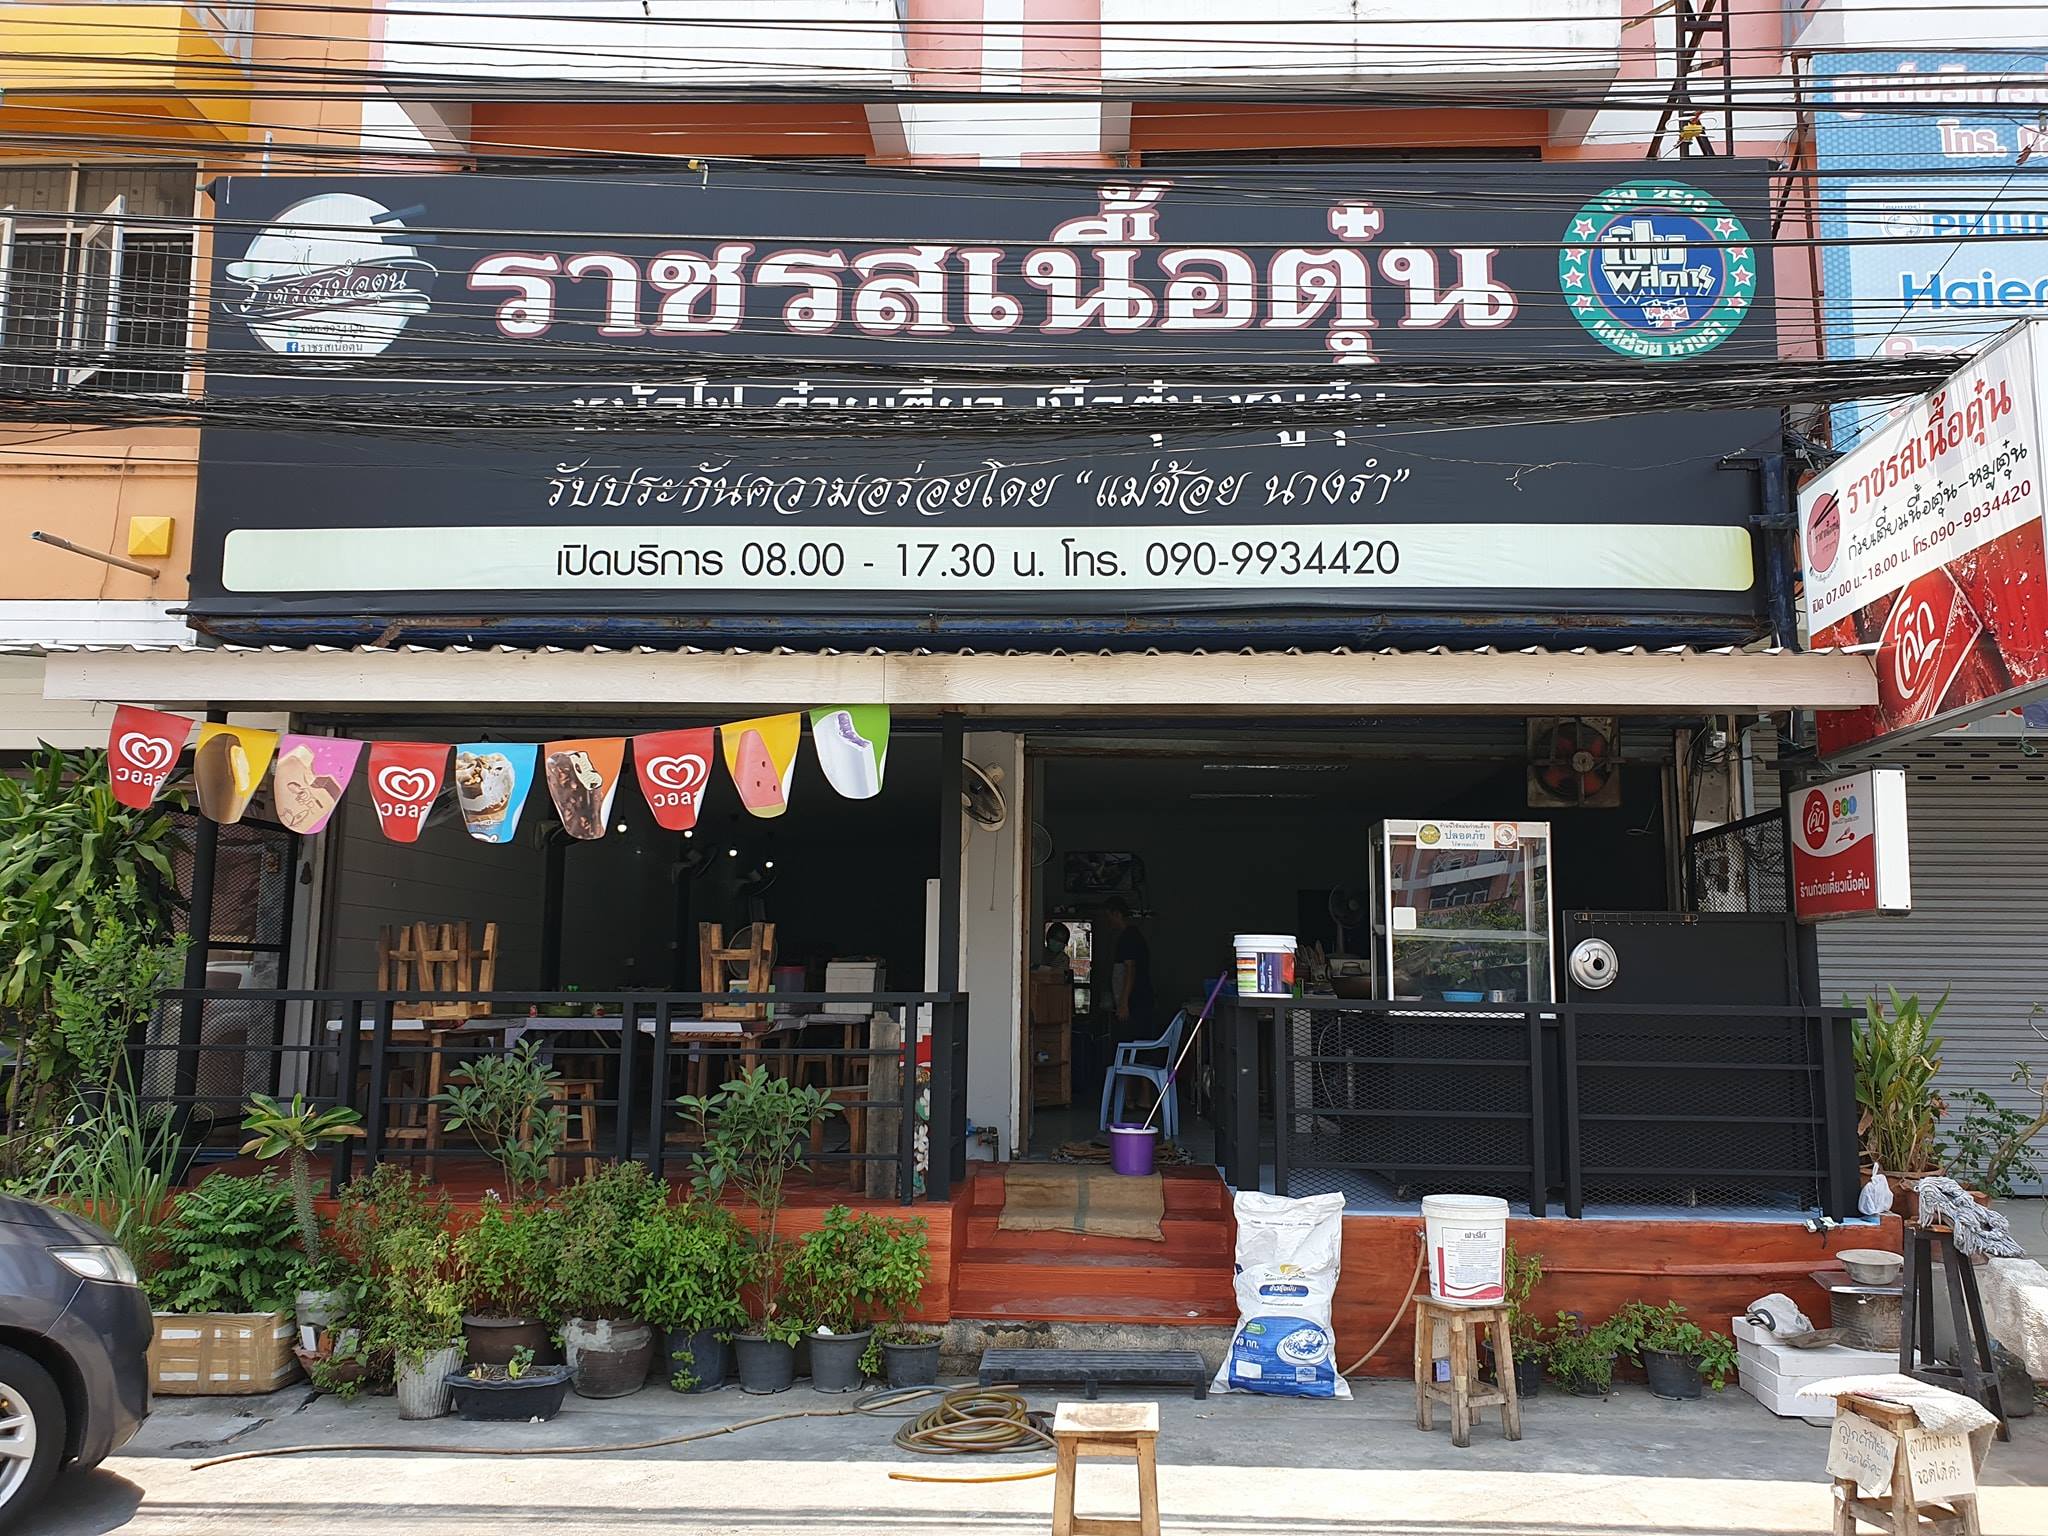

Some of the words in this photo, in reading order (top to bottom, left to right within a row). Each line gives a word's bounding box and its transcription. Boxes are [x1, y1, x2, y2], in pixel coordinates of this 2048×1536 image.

[467, 180, 1518, 364] ราชรสเนื้อตุ๋น
[1847, 379, 2012, 514] ราชรสเนื้อตุ๋น
[547, 456, 1063, 515] รับประกันความอร่อยโดย
[557, 544, 724, 577] เปิดบริการ
[741, 542, 845, 577] 08.00
[896, 542, 995, 577] 17.30
[1013, 551, 1044, 577] น.
[1062, 538, 1127, 577] โทร.
[1145, 541, 1400, 577] 090-9934420
[1812, 597, 1824, 614] เปิด
[1826, 581, 1851, 607] 07.00
[1901, 549, 1911, 563] น.
[1444, 830, 1485, 841] ปลอดภัย
